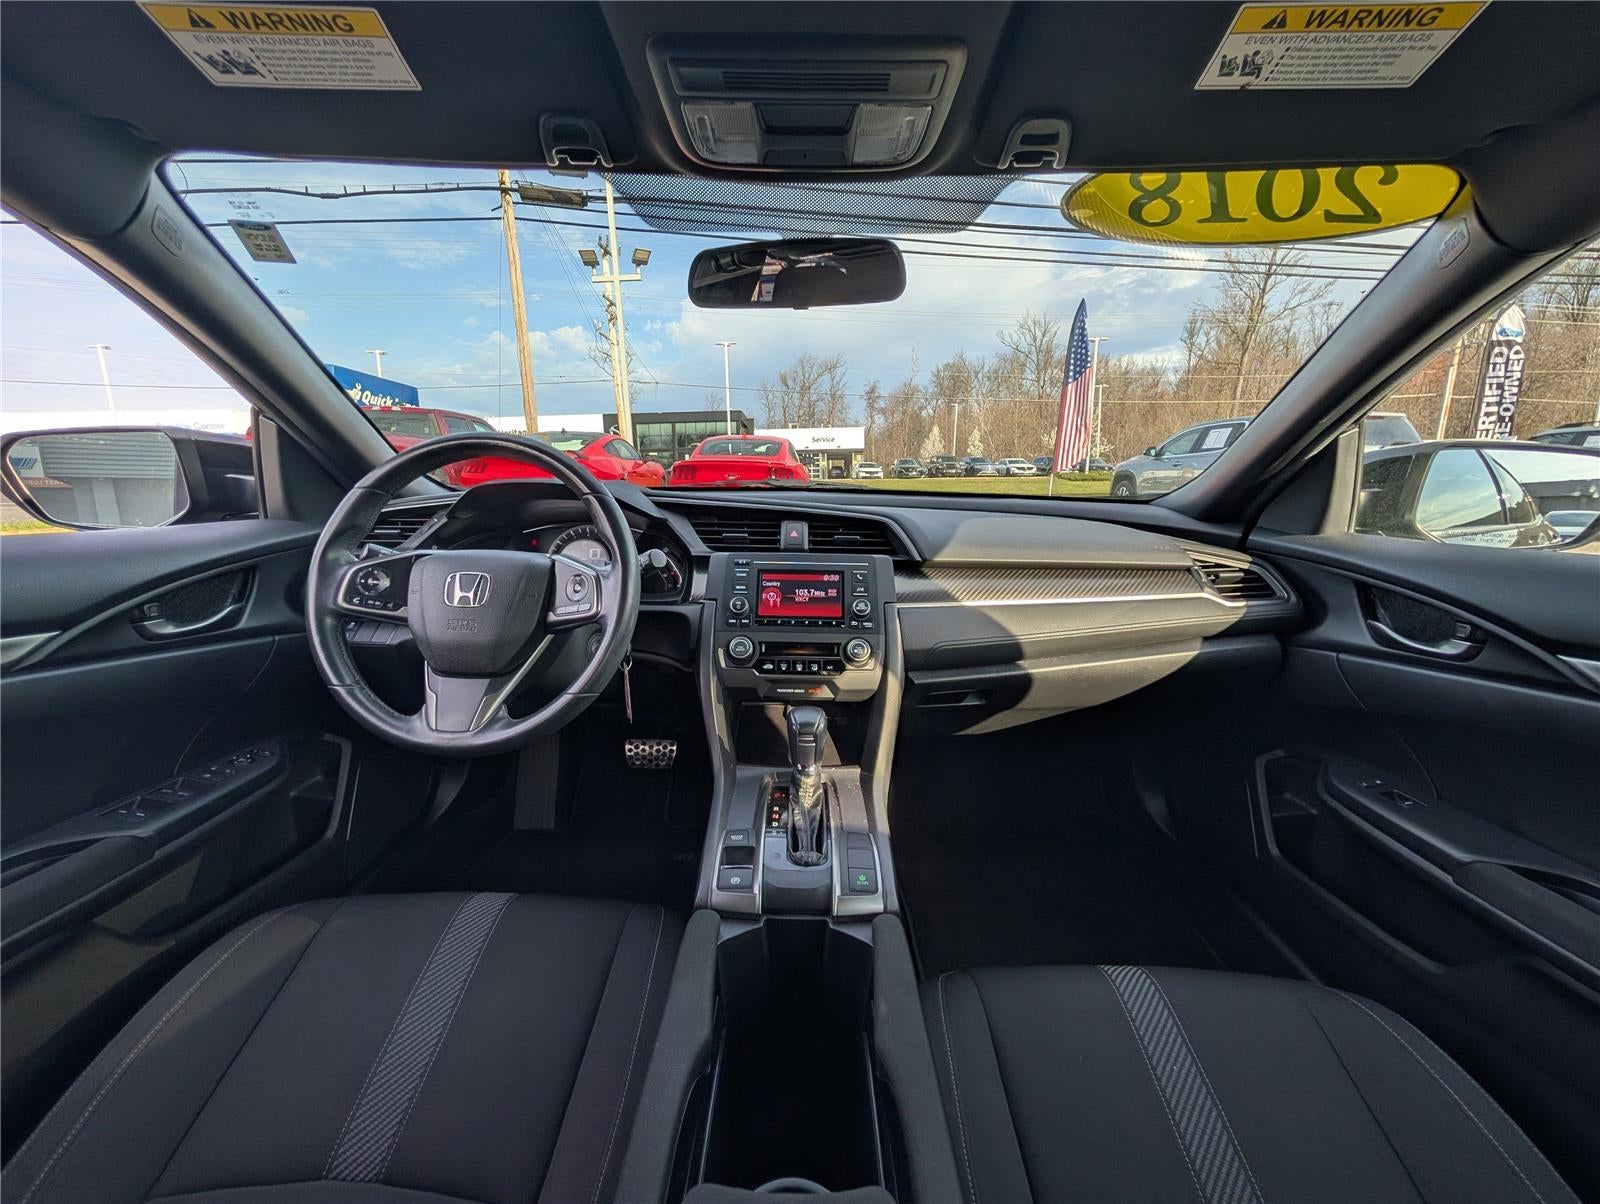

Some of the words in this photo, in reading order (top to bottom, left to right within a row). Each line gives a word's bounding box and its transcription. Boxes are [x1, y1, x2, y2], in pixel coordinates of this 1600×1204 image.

[219, 10, 355, 33] WARNING
[1303, 7, 1445, 29] WARNING
[193, 34, 228, 45] EVEN
[228, 35, 259, 46] WITH
[258, 36, 321, 47] ADVANCED
[322, 38, 343, 48] AIR
[343, 39, 376, 49] BAGS
[1244, 36, 1281, 45] EVEN
[1278, 35, 1311, 45] WITH
[1308, 34, 1376, 44] ADVANCED
[1374, 33, 1398, 43] AIR
[1398, 33, 1434, 43] BAGS
[361, 390, 394, 406] Quick
[1475, 346, 1508, 440] ERTIFIED
